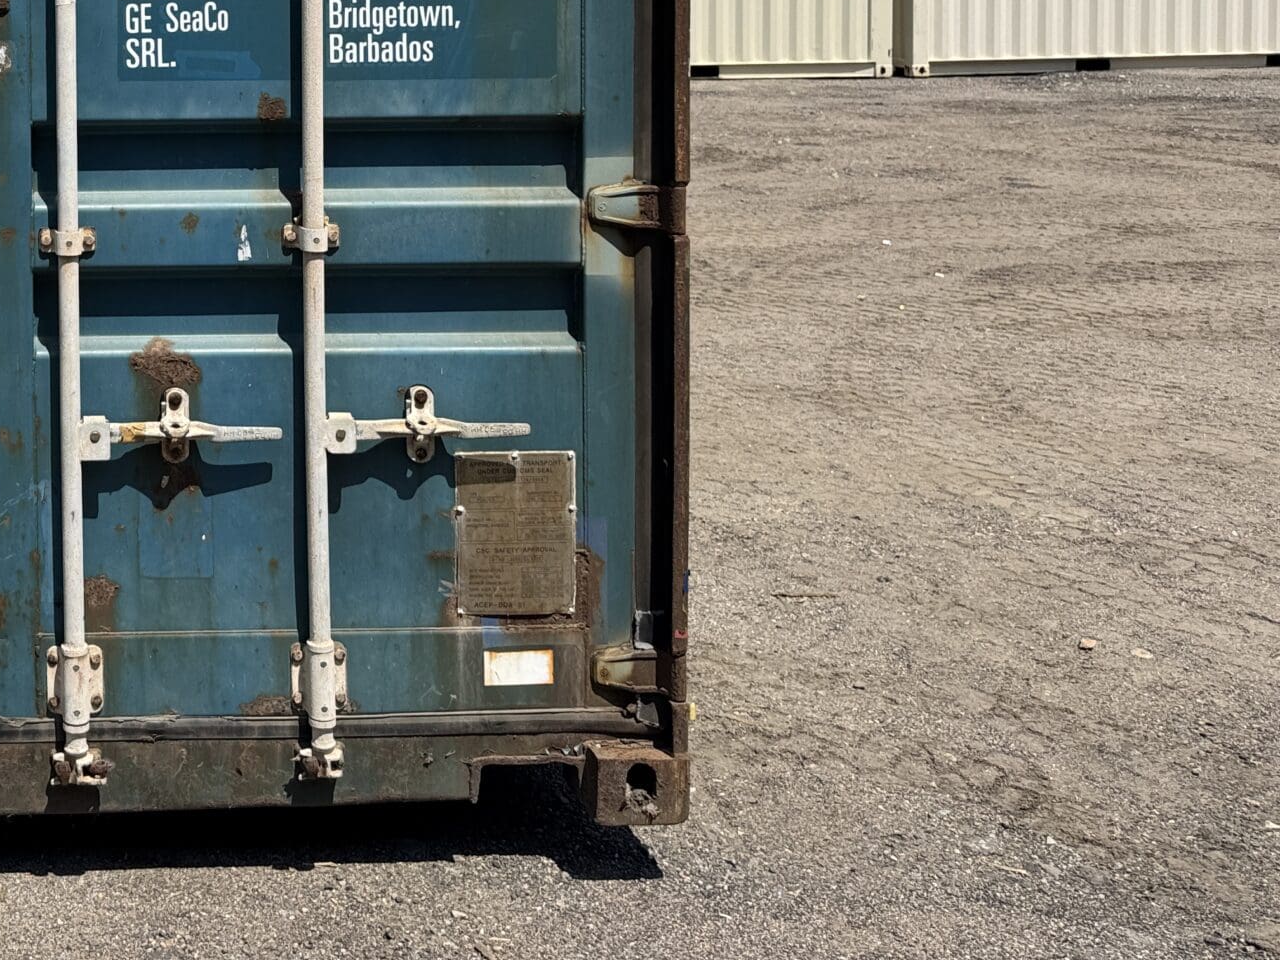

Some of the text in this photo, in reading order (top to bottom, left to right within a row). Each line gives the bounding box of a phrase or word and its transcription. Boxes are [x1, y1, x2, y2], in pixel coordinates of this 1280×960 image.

[125, 3, 152, 34] GE
[166, 0, 229, 33] SeaCo
[126, 34, 434, 69] SRL. Barbados
